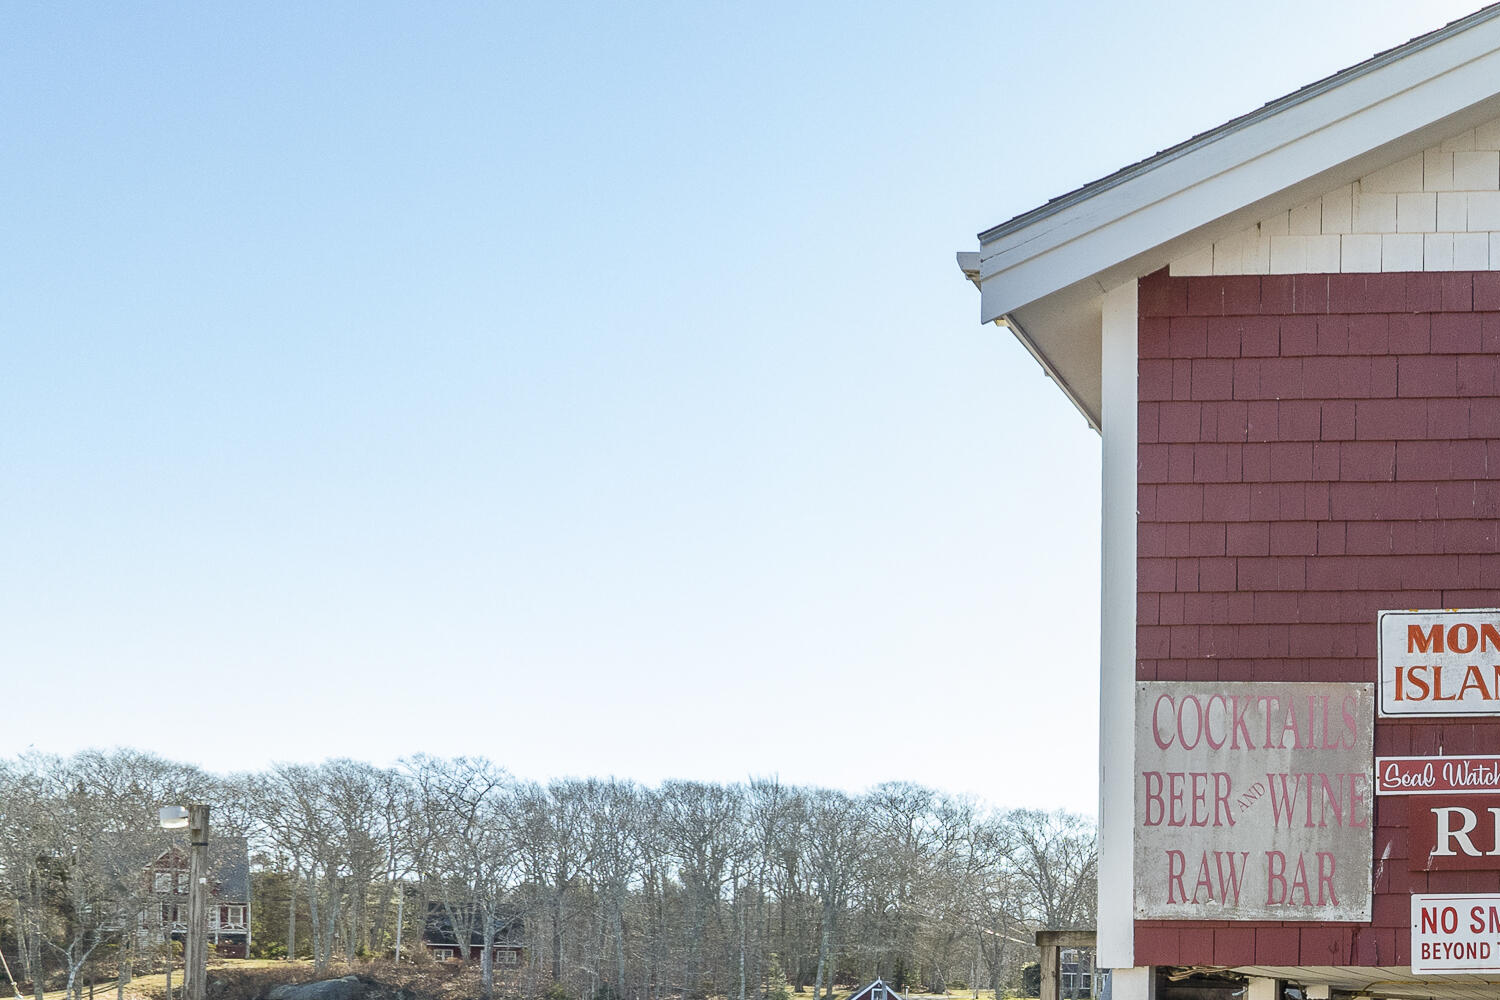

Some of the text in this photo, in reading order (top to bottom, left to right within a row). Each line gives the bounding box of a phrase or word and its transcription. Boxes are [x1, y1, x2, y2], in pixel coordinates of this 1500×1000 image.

[1152, 693, 1359, 751] COCKTAILS
[1382, 762, 1436, 789] Seal
[1142, 770, 1369, 829] BEER AND WINE
[1165, 849, 1340, 907] RAW BAR
[1421, 906, 1459, 935] NO
[1421, 941, 1491, 960] BEYOND
